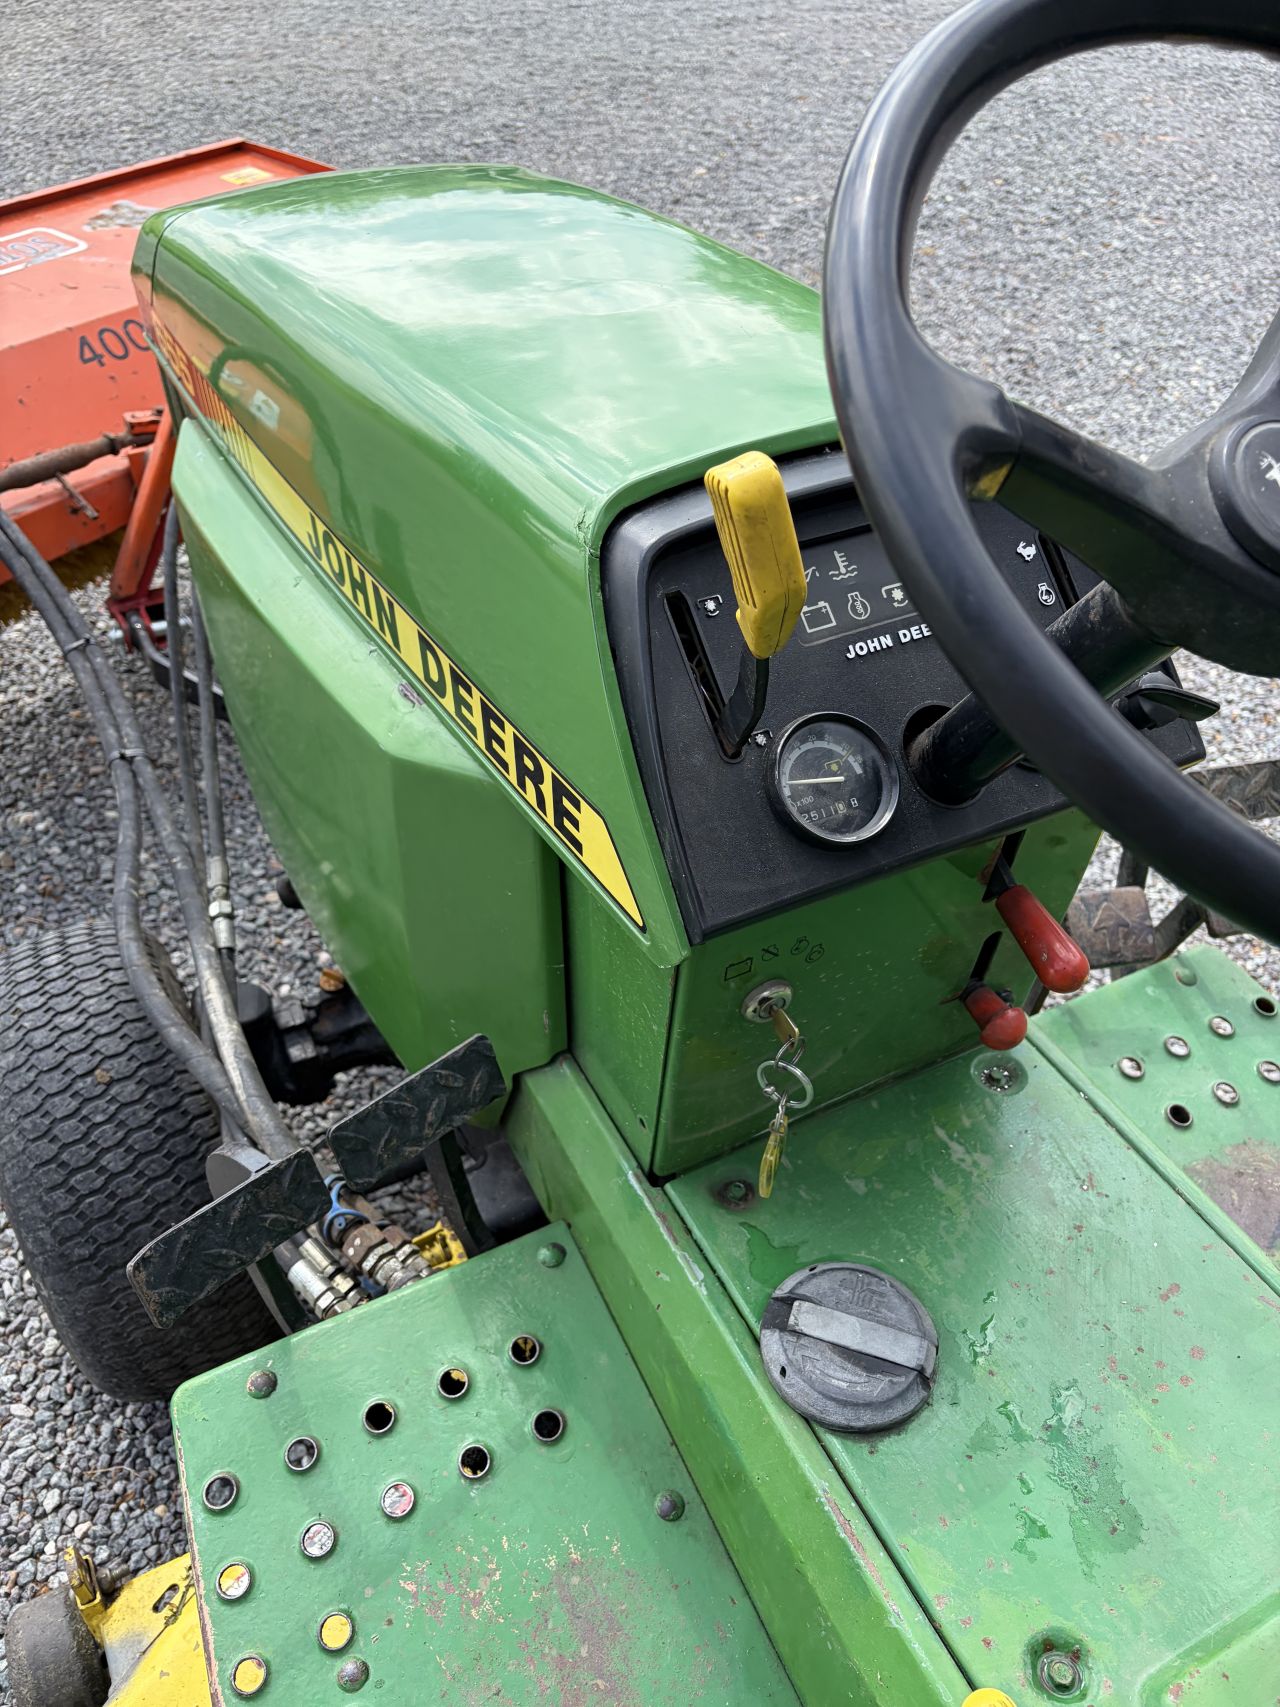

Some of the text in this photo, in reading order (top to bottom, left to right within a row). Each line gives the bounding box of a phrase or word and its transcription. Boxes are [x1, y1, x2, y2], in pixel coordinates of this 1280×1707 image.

[307, 511, 584, 858] JOHN DEERE
[846, 623, 932, 659] JOHN DEE
